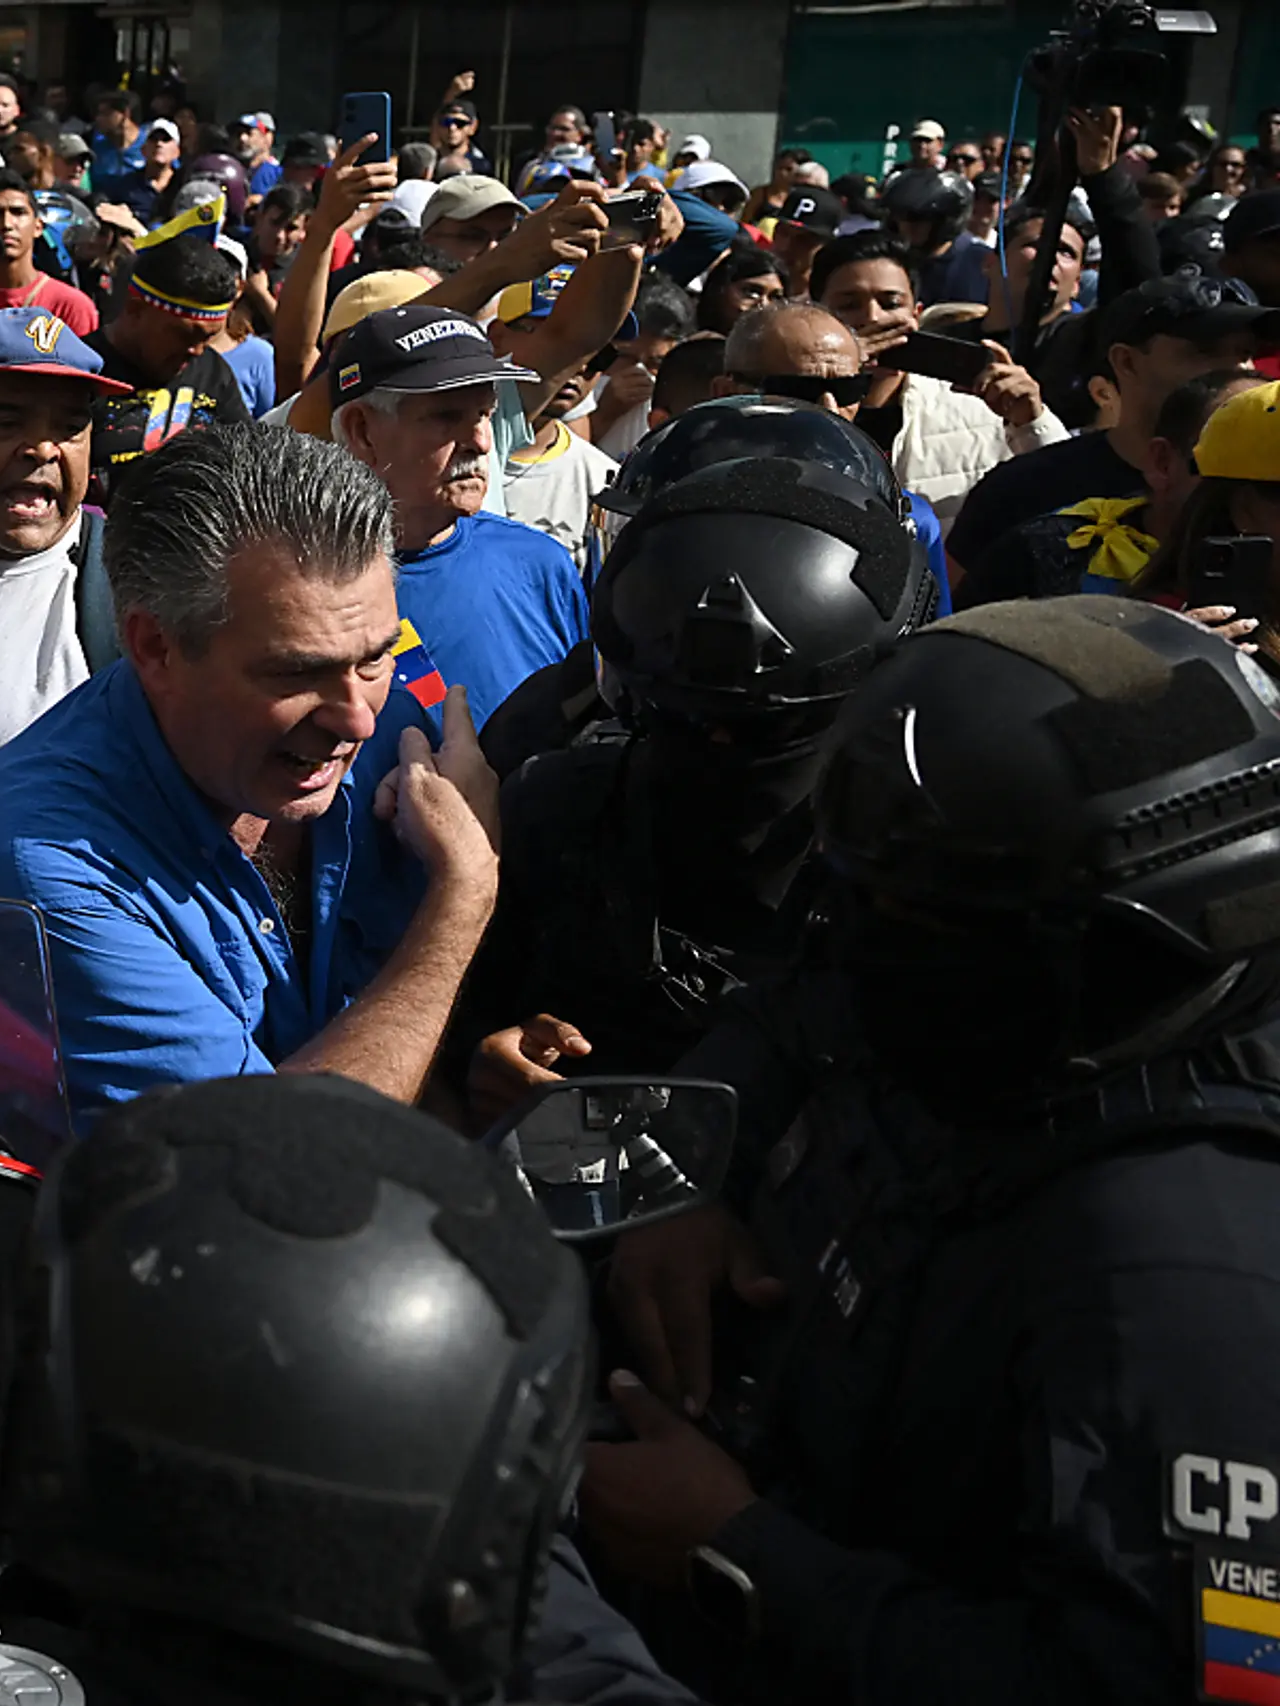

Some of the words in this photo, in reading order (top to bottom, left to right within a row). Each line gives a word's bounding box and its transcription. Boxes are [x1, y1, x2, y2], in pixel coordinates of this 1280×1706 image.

[793, 198, 816, 218] P
[1173, 1453, 1279, 1540] CP
[1209, 1556, 1280, 1604] VENE
